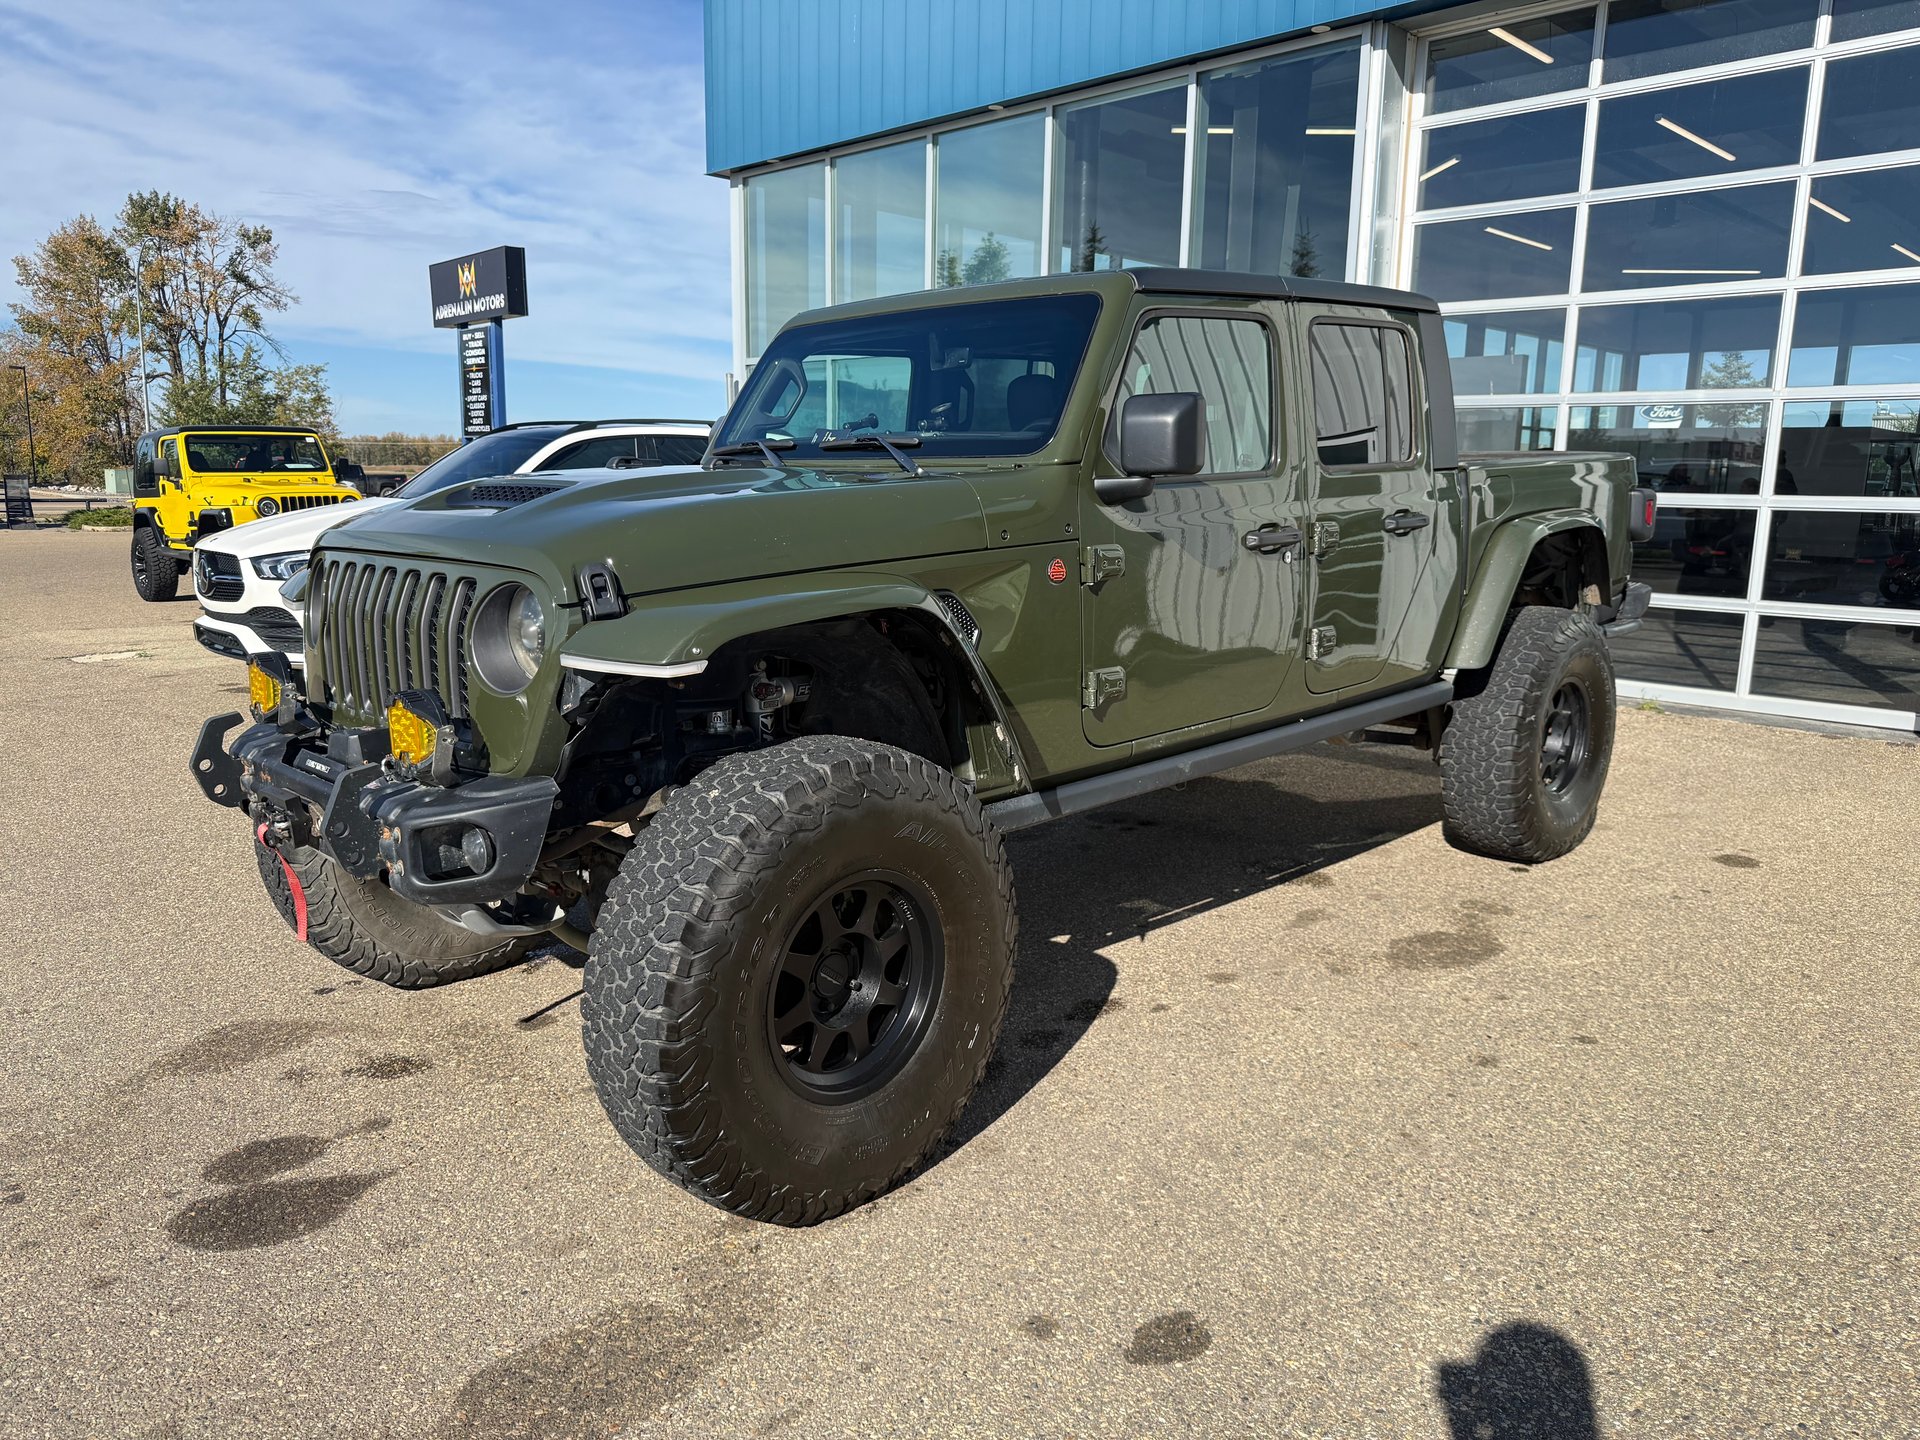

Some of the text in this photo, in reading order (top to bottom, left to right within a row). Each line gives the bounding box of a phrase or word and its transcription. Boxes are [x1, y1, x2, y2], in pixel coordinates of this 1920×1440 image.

[435, 293, 505, 320] ADRENALIN MOTORS
[462, 331, 485, 341] BUY SELL
[468, 340, 483, 348] TRADE
[465, 348, 486, 357] CONSIGN
[466, 356, 486, 365] SERVICE
[469, 371, 484, 379] TRUCKS
[471, 379, 482, 387] CARS
[477, 394, 488, 402] CARS
[1650, 405, 1682, 418] Ford
